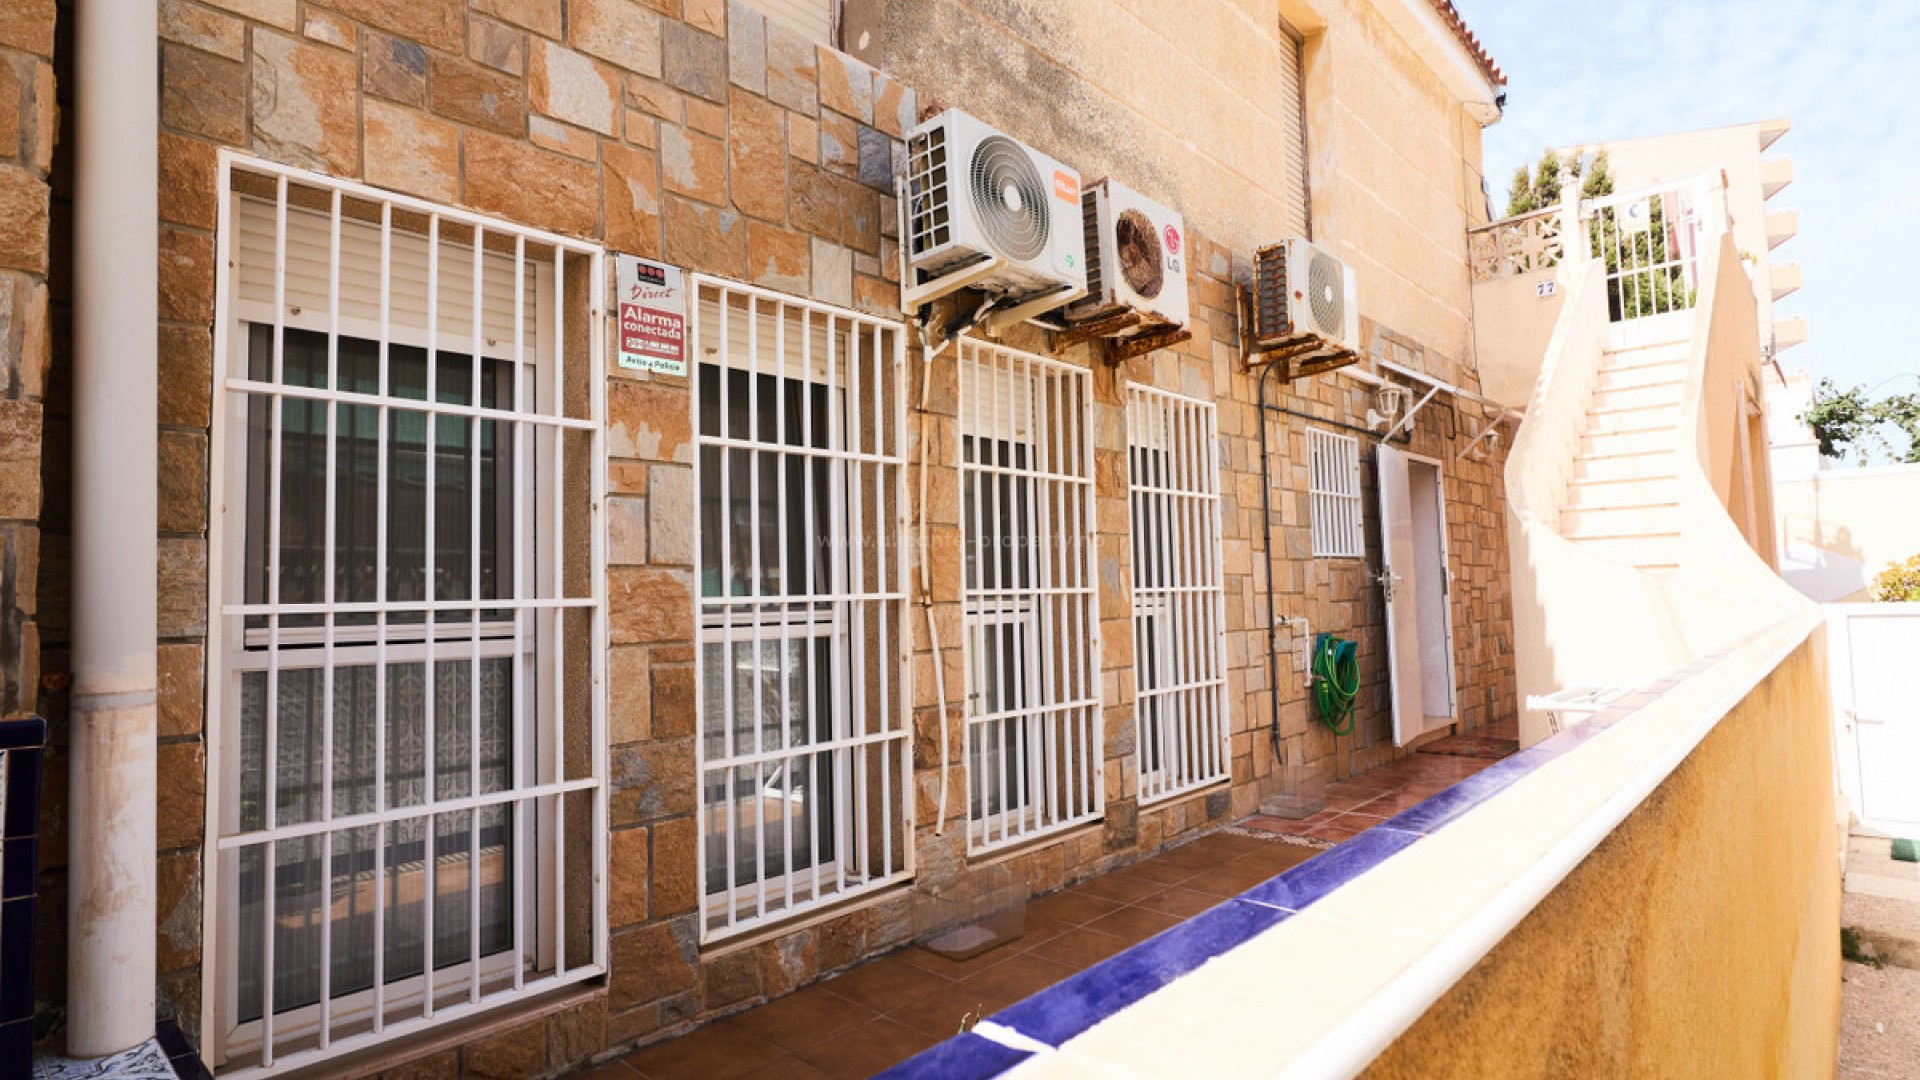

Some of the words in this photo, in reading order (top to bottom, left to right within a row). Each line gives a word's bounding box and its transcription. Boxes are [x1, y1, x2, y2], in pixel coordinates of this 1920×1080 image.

[1167, 256, 1180, 273] LG
[628, 284, 677, 300] Direct
[624, 306, 681, 329] Alarma
[624, 321, 681, 340] conectada
